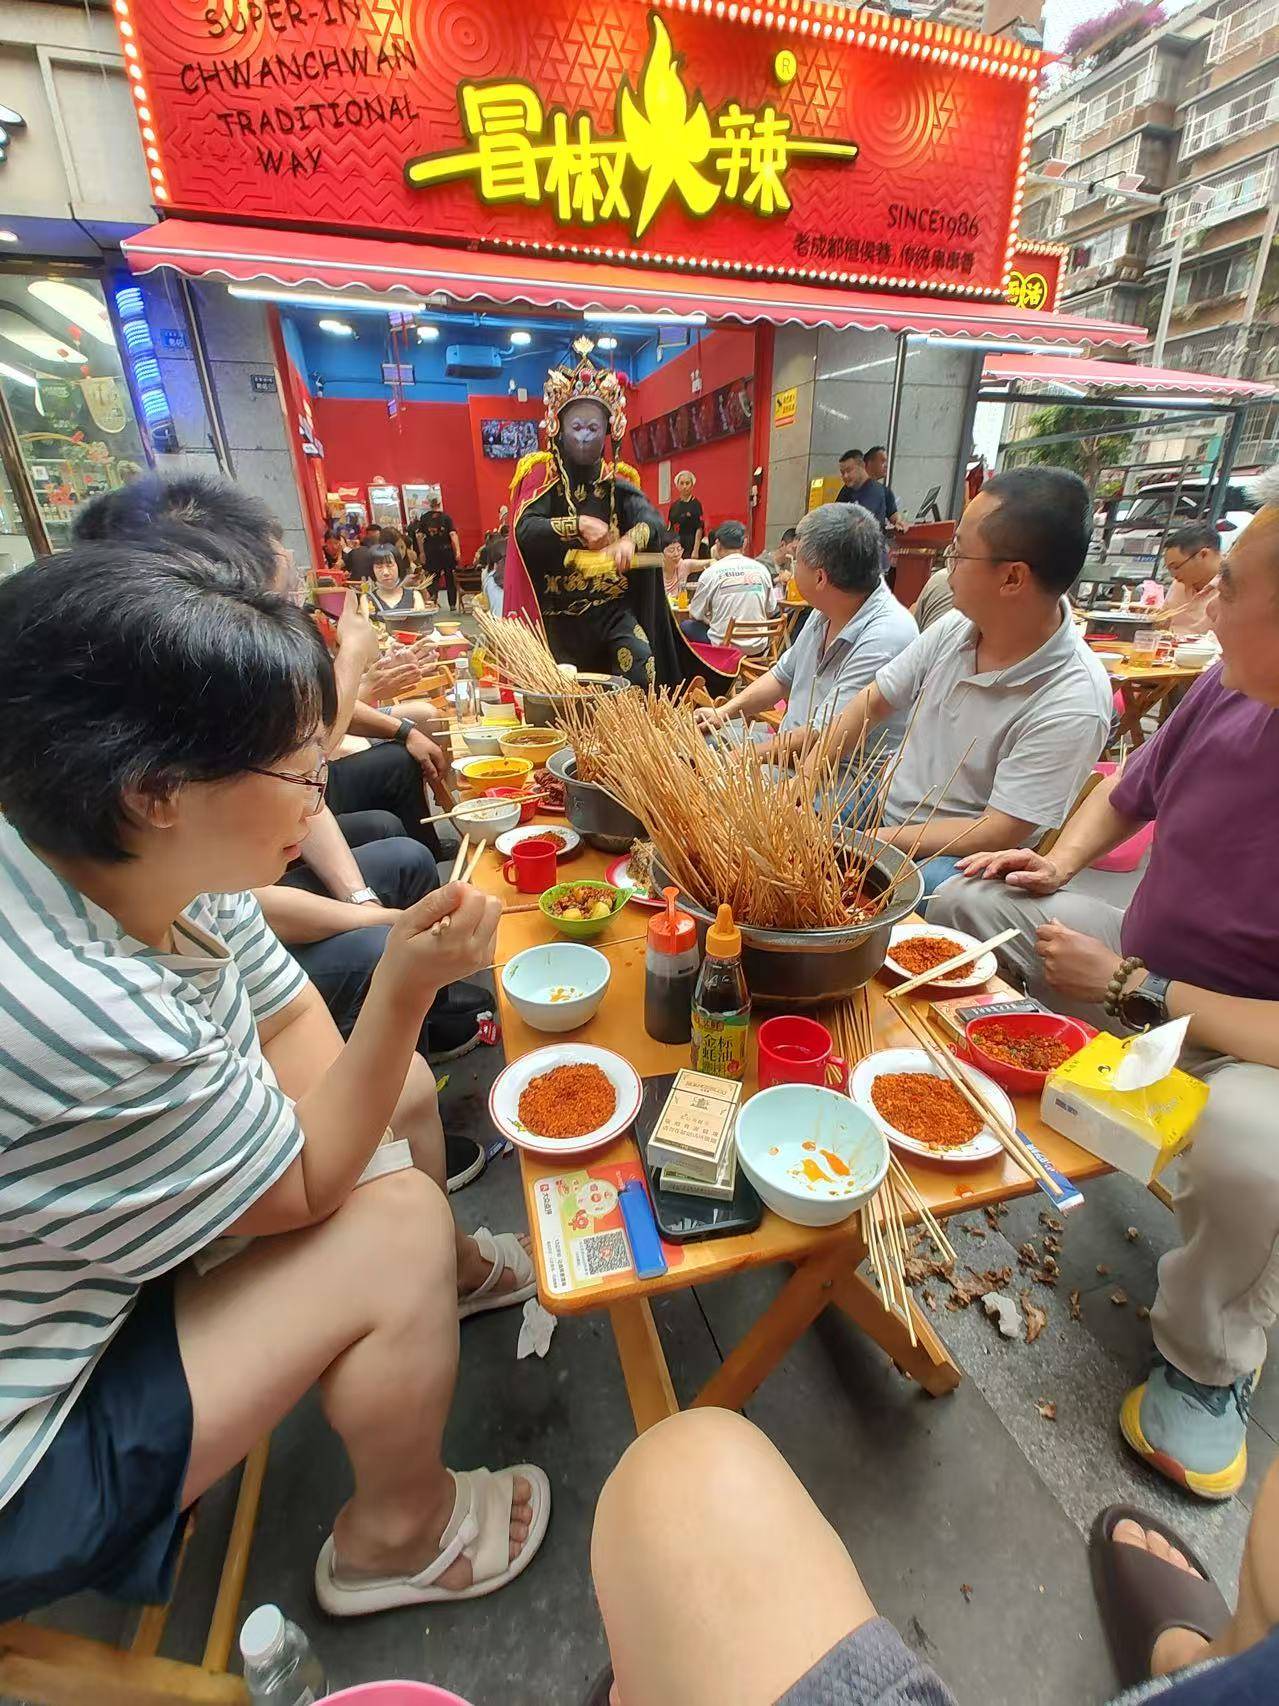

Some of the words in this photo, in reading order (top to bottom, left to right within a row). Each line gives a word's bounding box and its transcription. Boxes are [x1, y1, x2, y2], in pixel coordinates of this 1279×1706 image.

[204, 0, 361, 38] SUPER-IN
[180, 41, 417, 94] CHWANCHWAN
[217, 95, 419, 138] TRADITIONAL
[461, 14, 793, 238] 冒椒火辣
[257, 144, 322, 177] WAY
